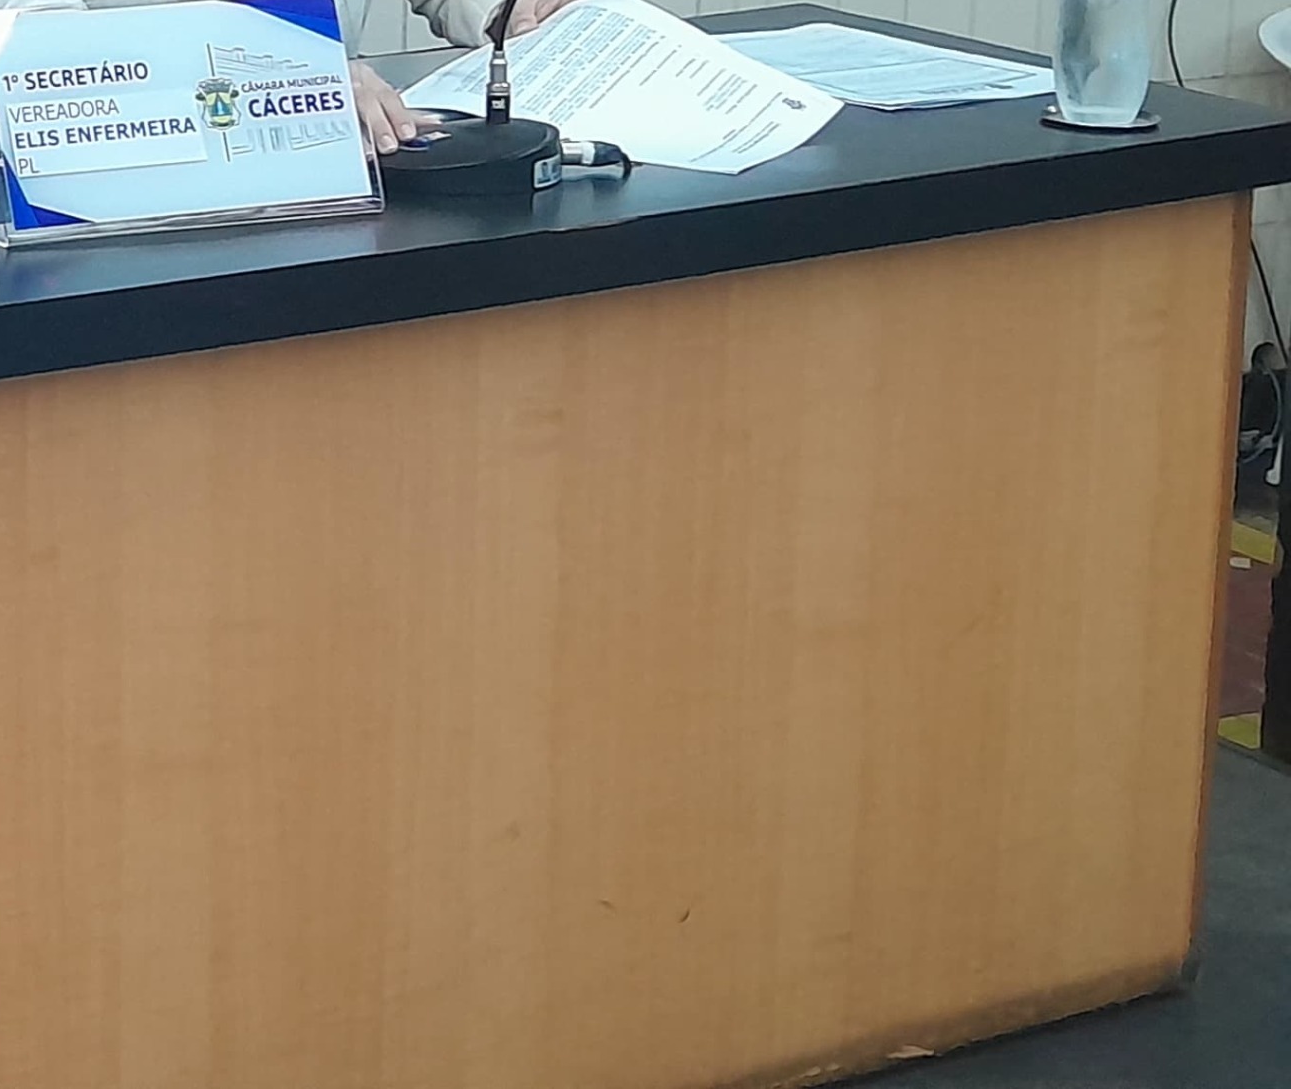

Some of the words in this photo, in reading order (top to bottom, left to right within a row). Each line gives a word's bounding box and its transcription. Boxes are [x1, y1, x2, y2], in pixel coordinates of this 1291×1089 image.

[25, 60, 149, 91] SECRETÁRIO
[287, 74, 343, 89] MUNICIPAL
[9, 98, 120, 124] VEREADORA
[248, 91, 345, 119] CÁCERES
[15, 129, 60, 149] ELIS
[66, 117, 196, 144] ENFERMEIRA
[19, 157, 40, 175] PL
